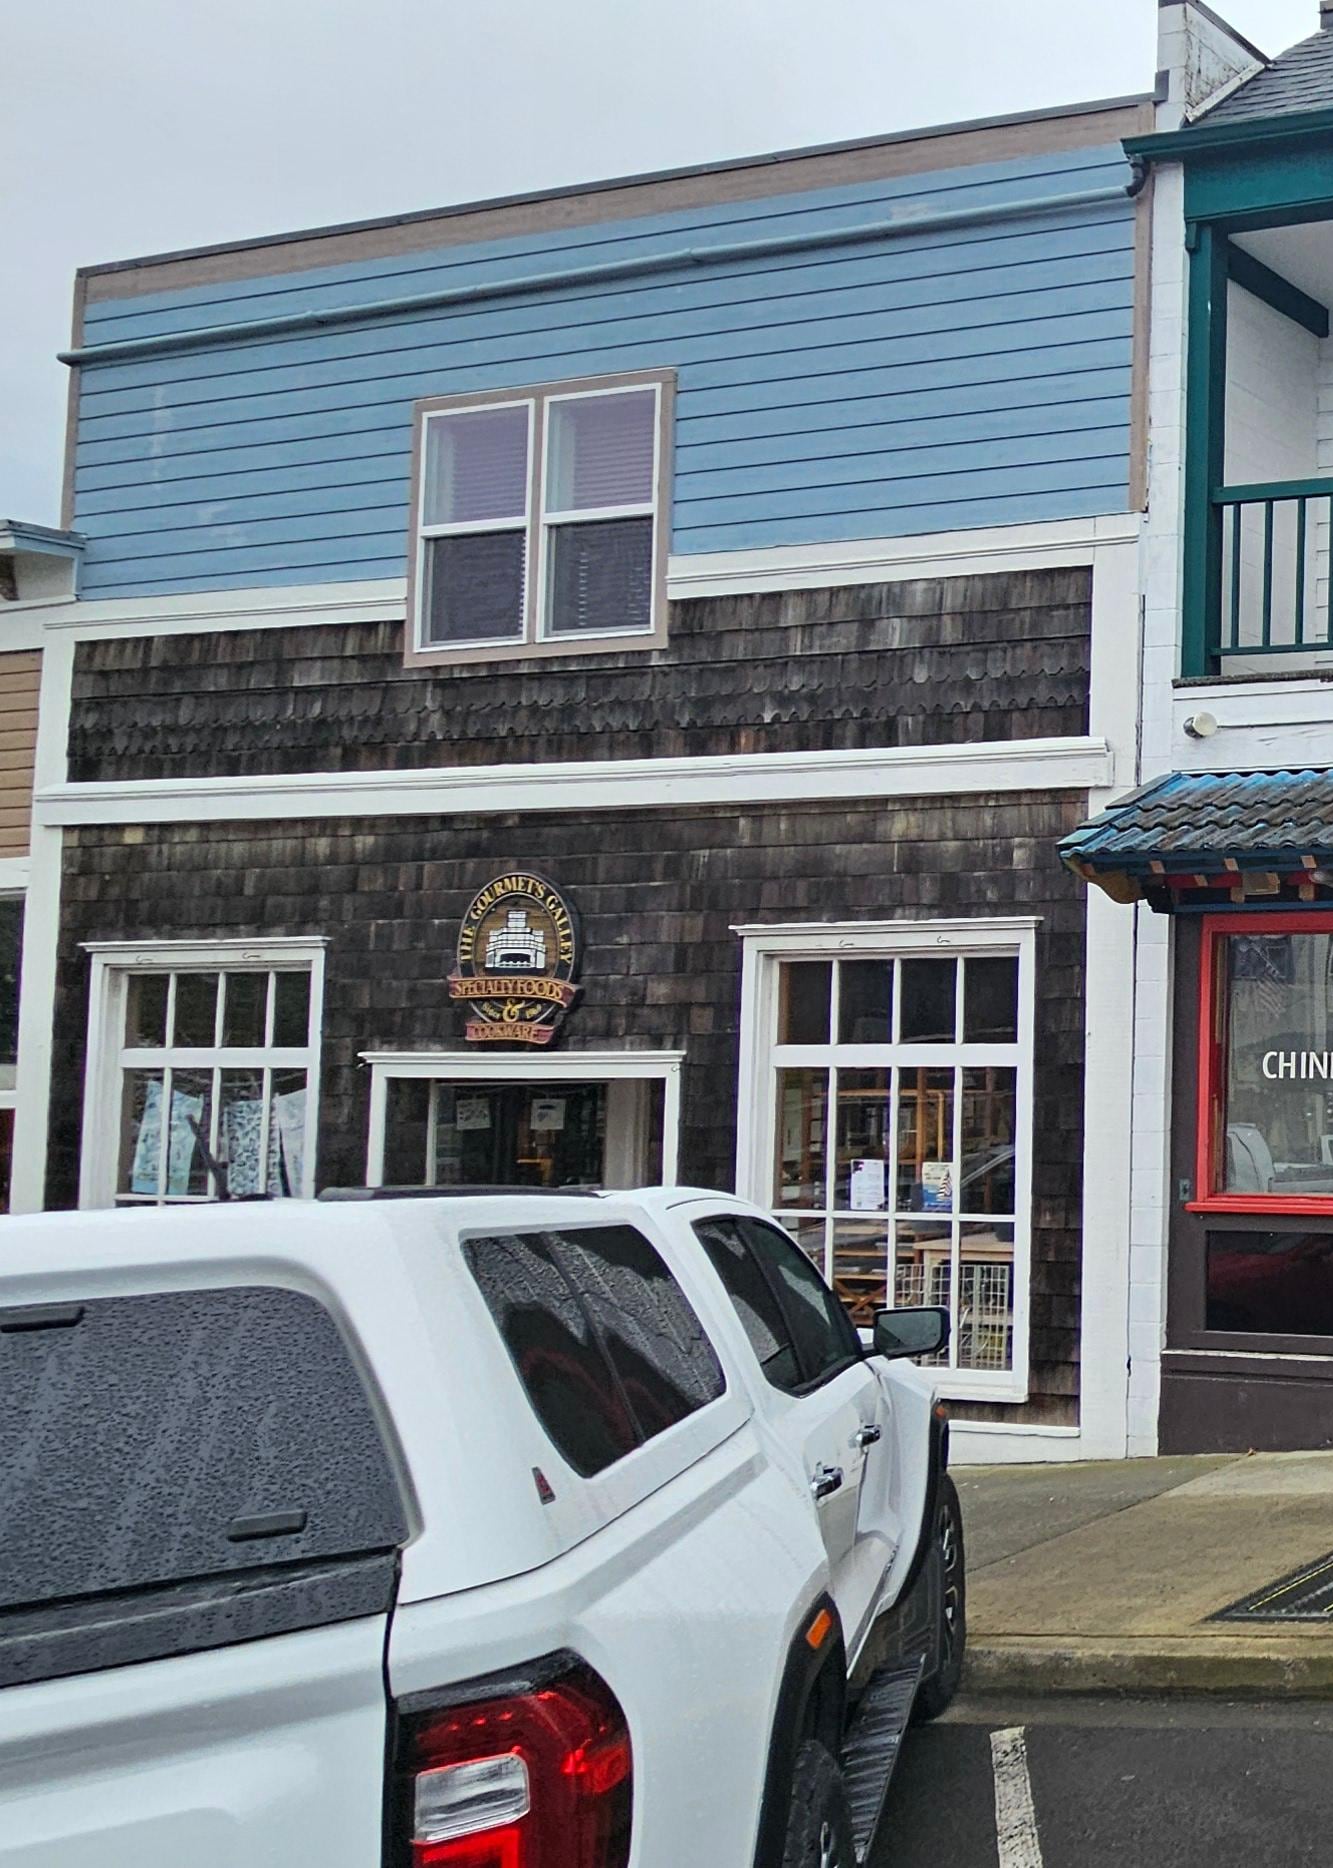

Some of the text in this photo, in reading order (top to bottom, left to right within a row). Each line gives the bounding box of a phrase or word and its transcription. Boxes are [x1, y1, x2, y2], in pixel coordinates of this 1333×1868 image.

[460, 876, 573, 965] THE GOURMET'S GALLEY
[455, 979, 563, 999] SPECIALTY FOODS
[502, 998, 525, 1022] &
